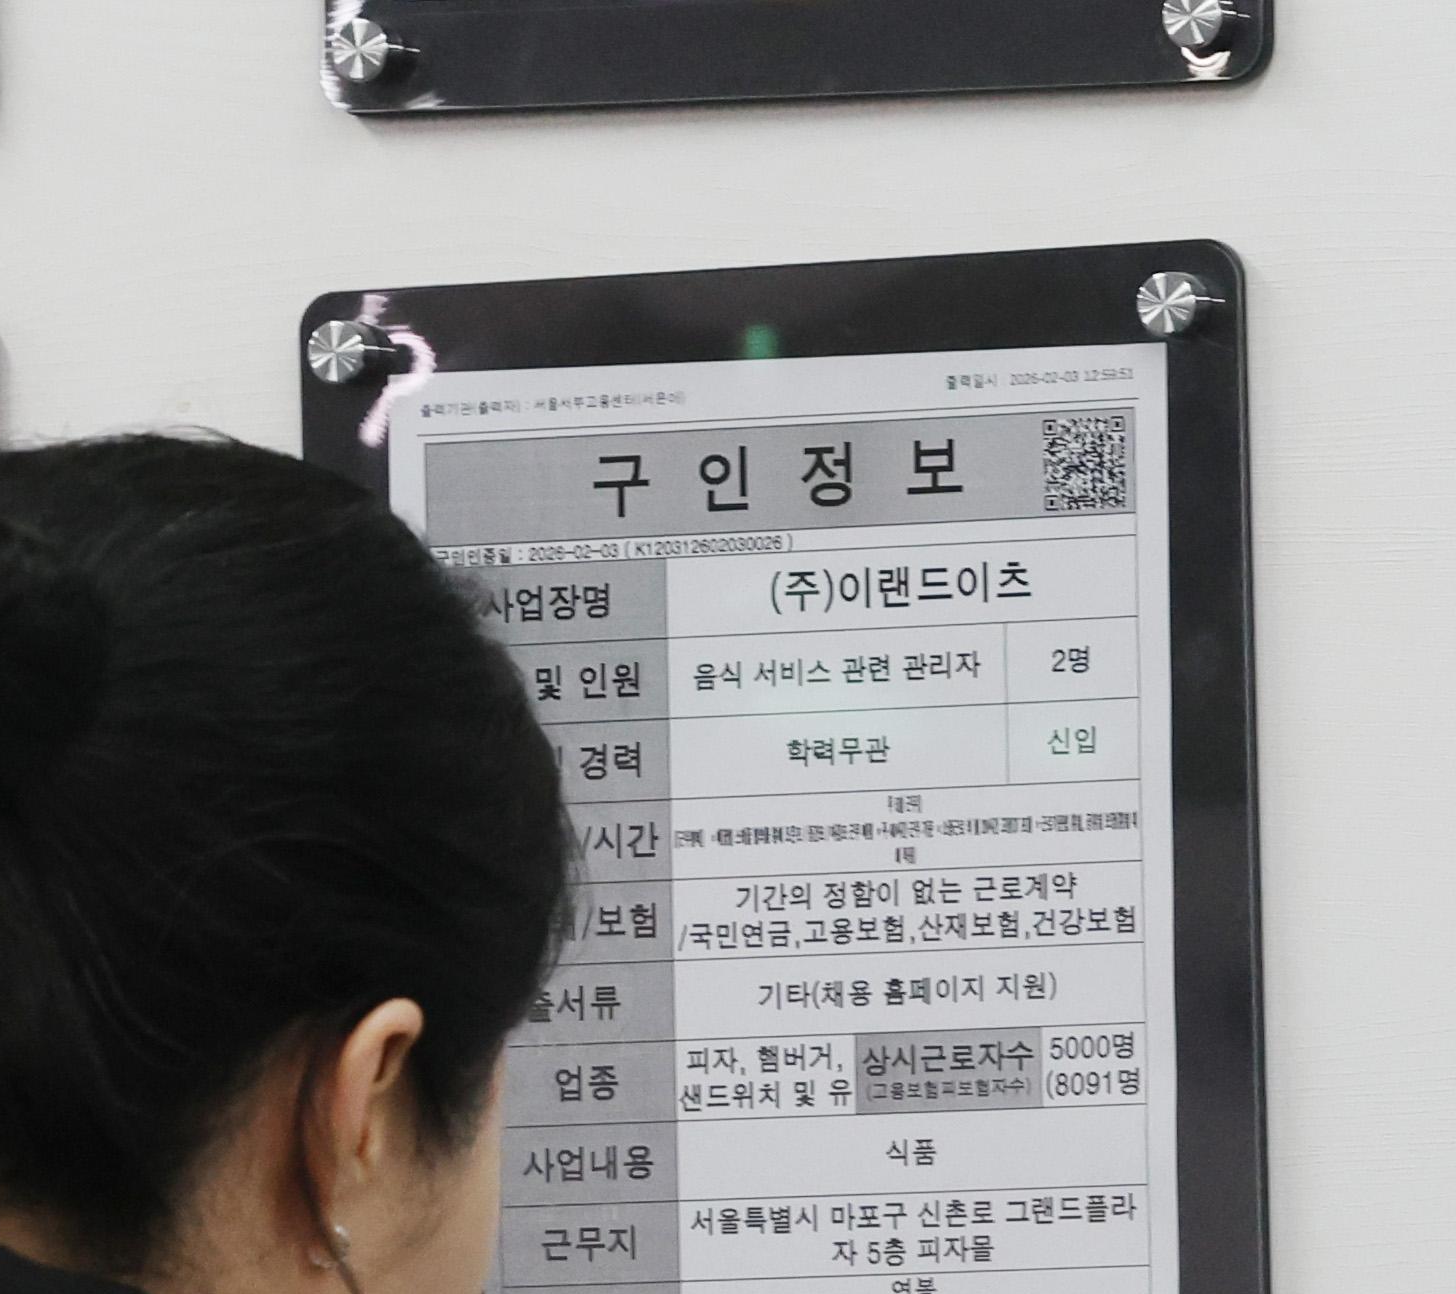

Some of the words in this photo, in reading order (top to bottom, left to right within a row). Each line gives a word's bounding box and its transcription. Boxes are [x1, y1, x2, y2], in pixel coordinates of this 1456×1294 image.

[771, 561, 1032, 615] (주)이랜드이츠
[693, 661, 741, 692] 음식
[753, 658, 832, 687] 서비스
[842, 654, 890, 684] 관련
[902, 650, 981, 681] 관리자
[1051, 645, 1090, 674] 2명
[786, 736, 891, 767] 학력무관
[736, 882, 811, 913] 기간의
[823, 879, 899, 910] 정함이
[912, 877, 963, 905] 없는
[973, 871, 1077, 902] 근로계약
[523, 1145, 655, 1183] 사업내용
[885, 1138, 937, 1166] 식품
[690, 1204, 818, 1235] 서울특별시
[831, 1202, 908, 1231] 마포구
[917, 1199, 995, 1228] 신촌로
[1005, 1193, 1137, 1225] 그랜드플라
[832, 1239, 858, 1267] 자
[867, 1237, 907, 1267] 5층
[917, 1234, 995, 1264] 피자몰
